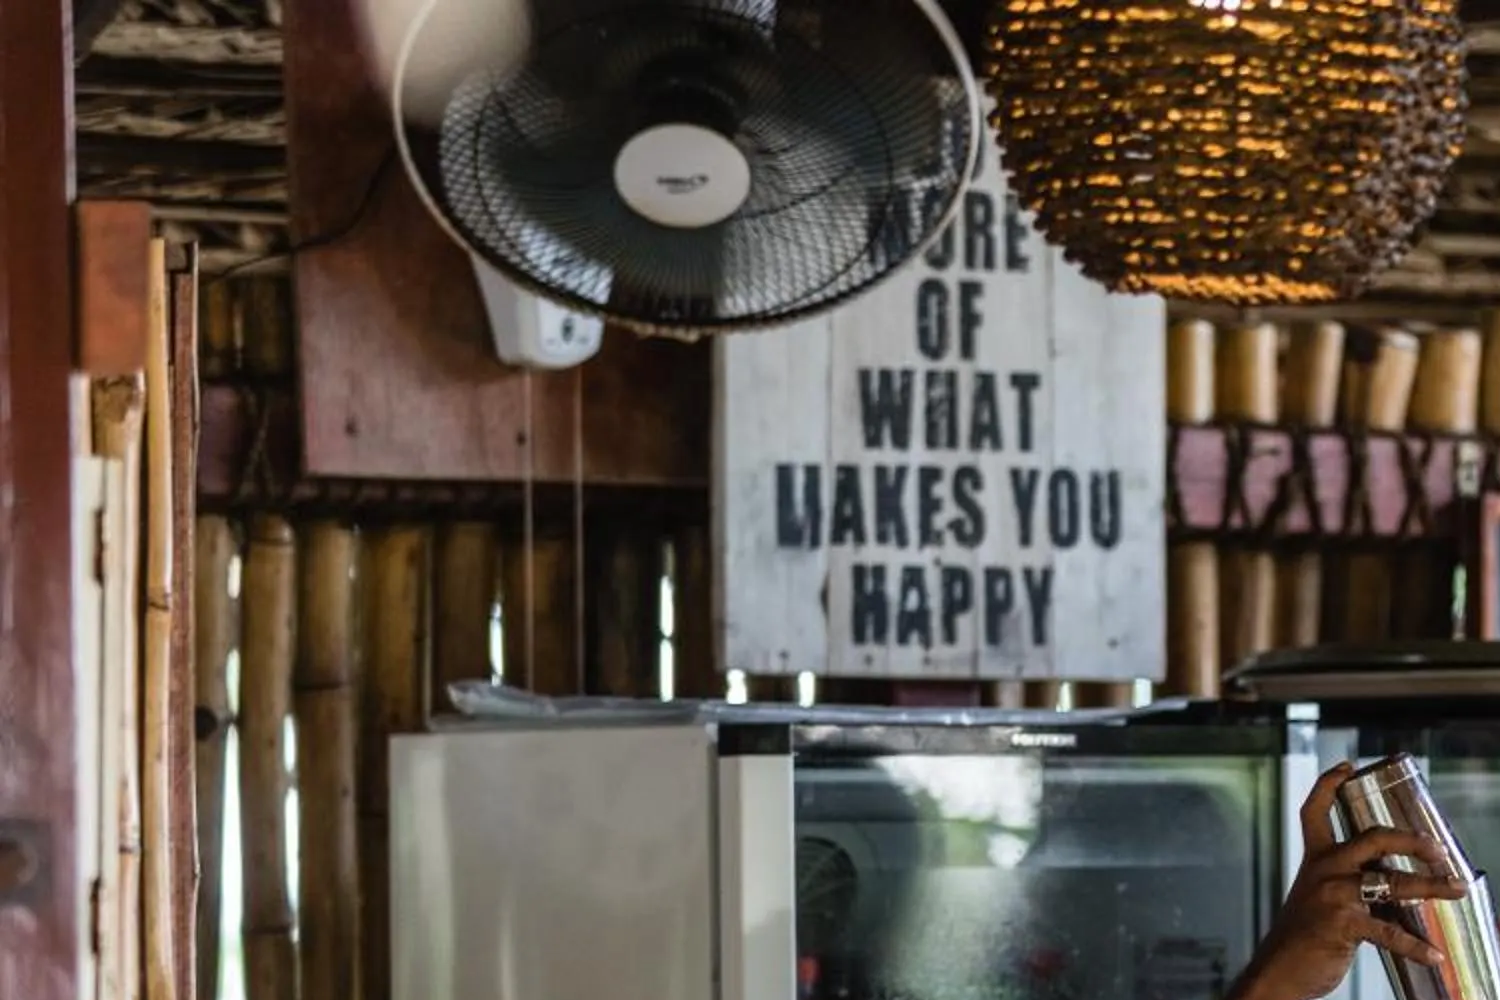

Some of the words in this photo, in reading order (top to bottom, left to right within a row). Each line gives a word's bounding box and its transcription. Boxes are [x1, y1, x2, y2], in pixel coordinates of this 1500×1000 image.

[914, 278, 986, 361] OF
[857, 366, 1042, 452] WHAT
[1009, 467, 1124, 551] YOU
[851, 563, 1055, 650] HAPPY
